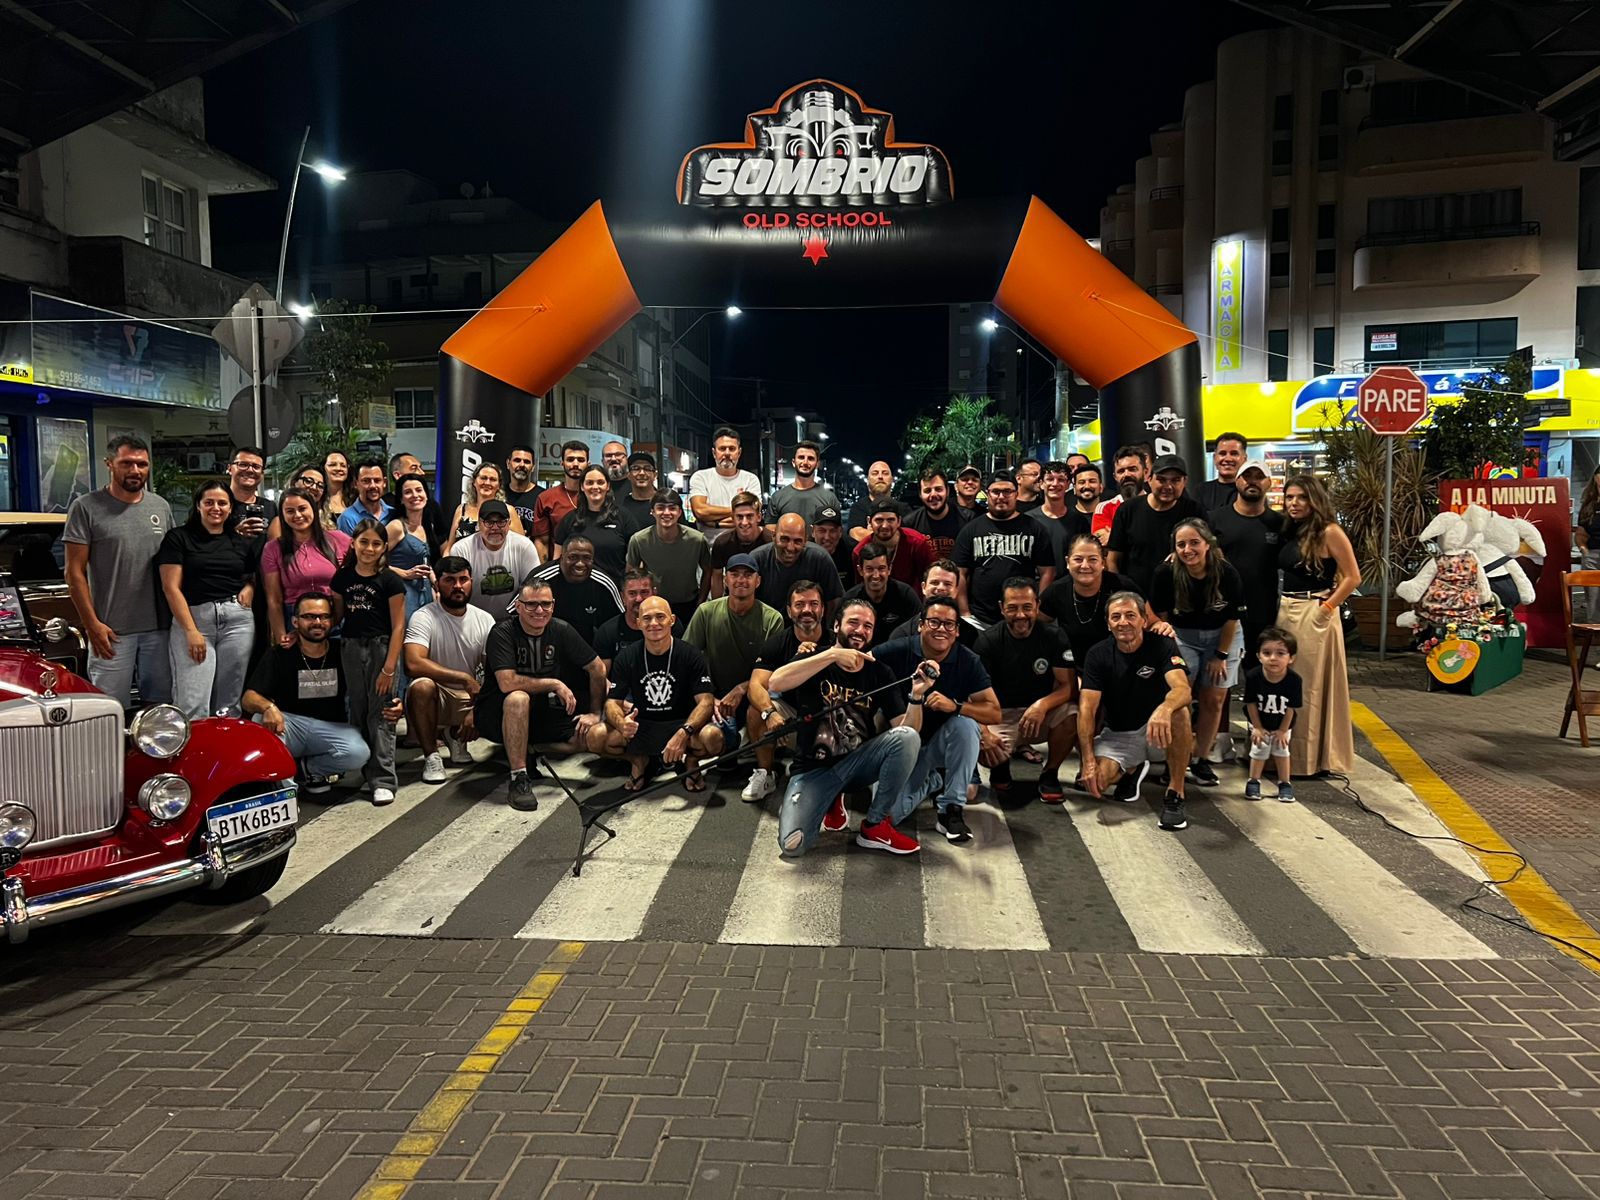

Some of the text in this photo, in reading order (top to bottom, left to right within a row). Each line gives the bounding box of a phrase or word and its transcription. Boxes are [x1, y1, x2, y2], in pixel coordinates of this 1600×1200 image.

[699, 156, 928, 196] SOMBRIO
[743, 211, 891, 229] OLD SCHOOL
[1220, 250, 1233, 367] ARMACIA
[1364, 389, 1421, 412] PARE
[1451, 486, 1557, 506] A LA MINUTA
[218, 803, 291, 838] BTK6B51
